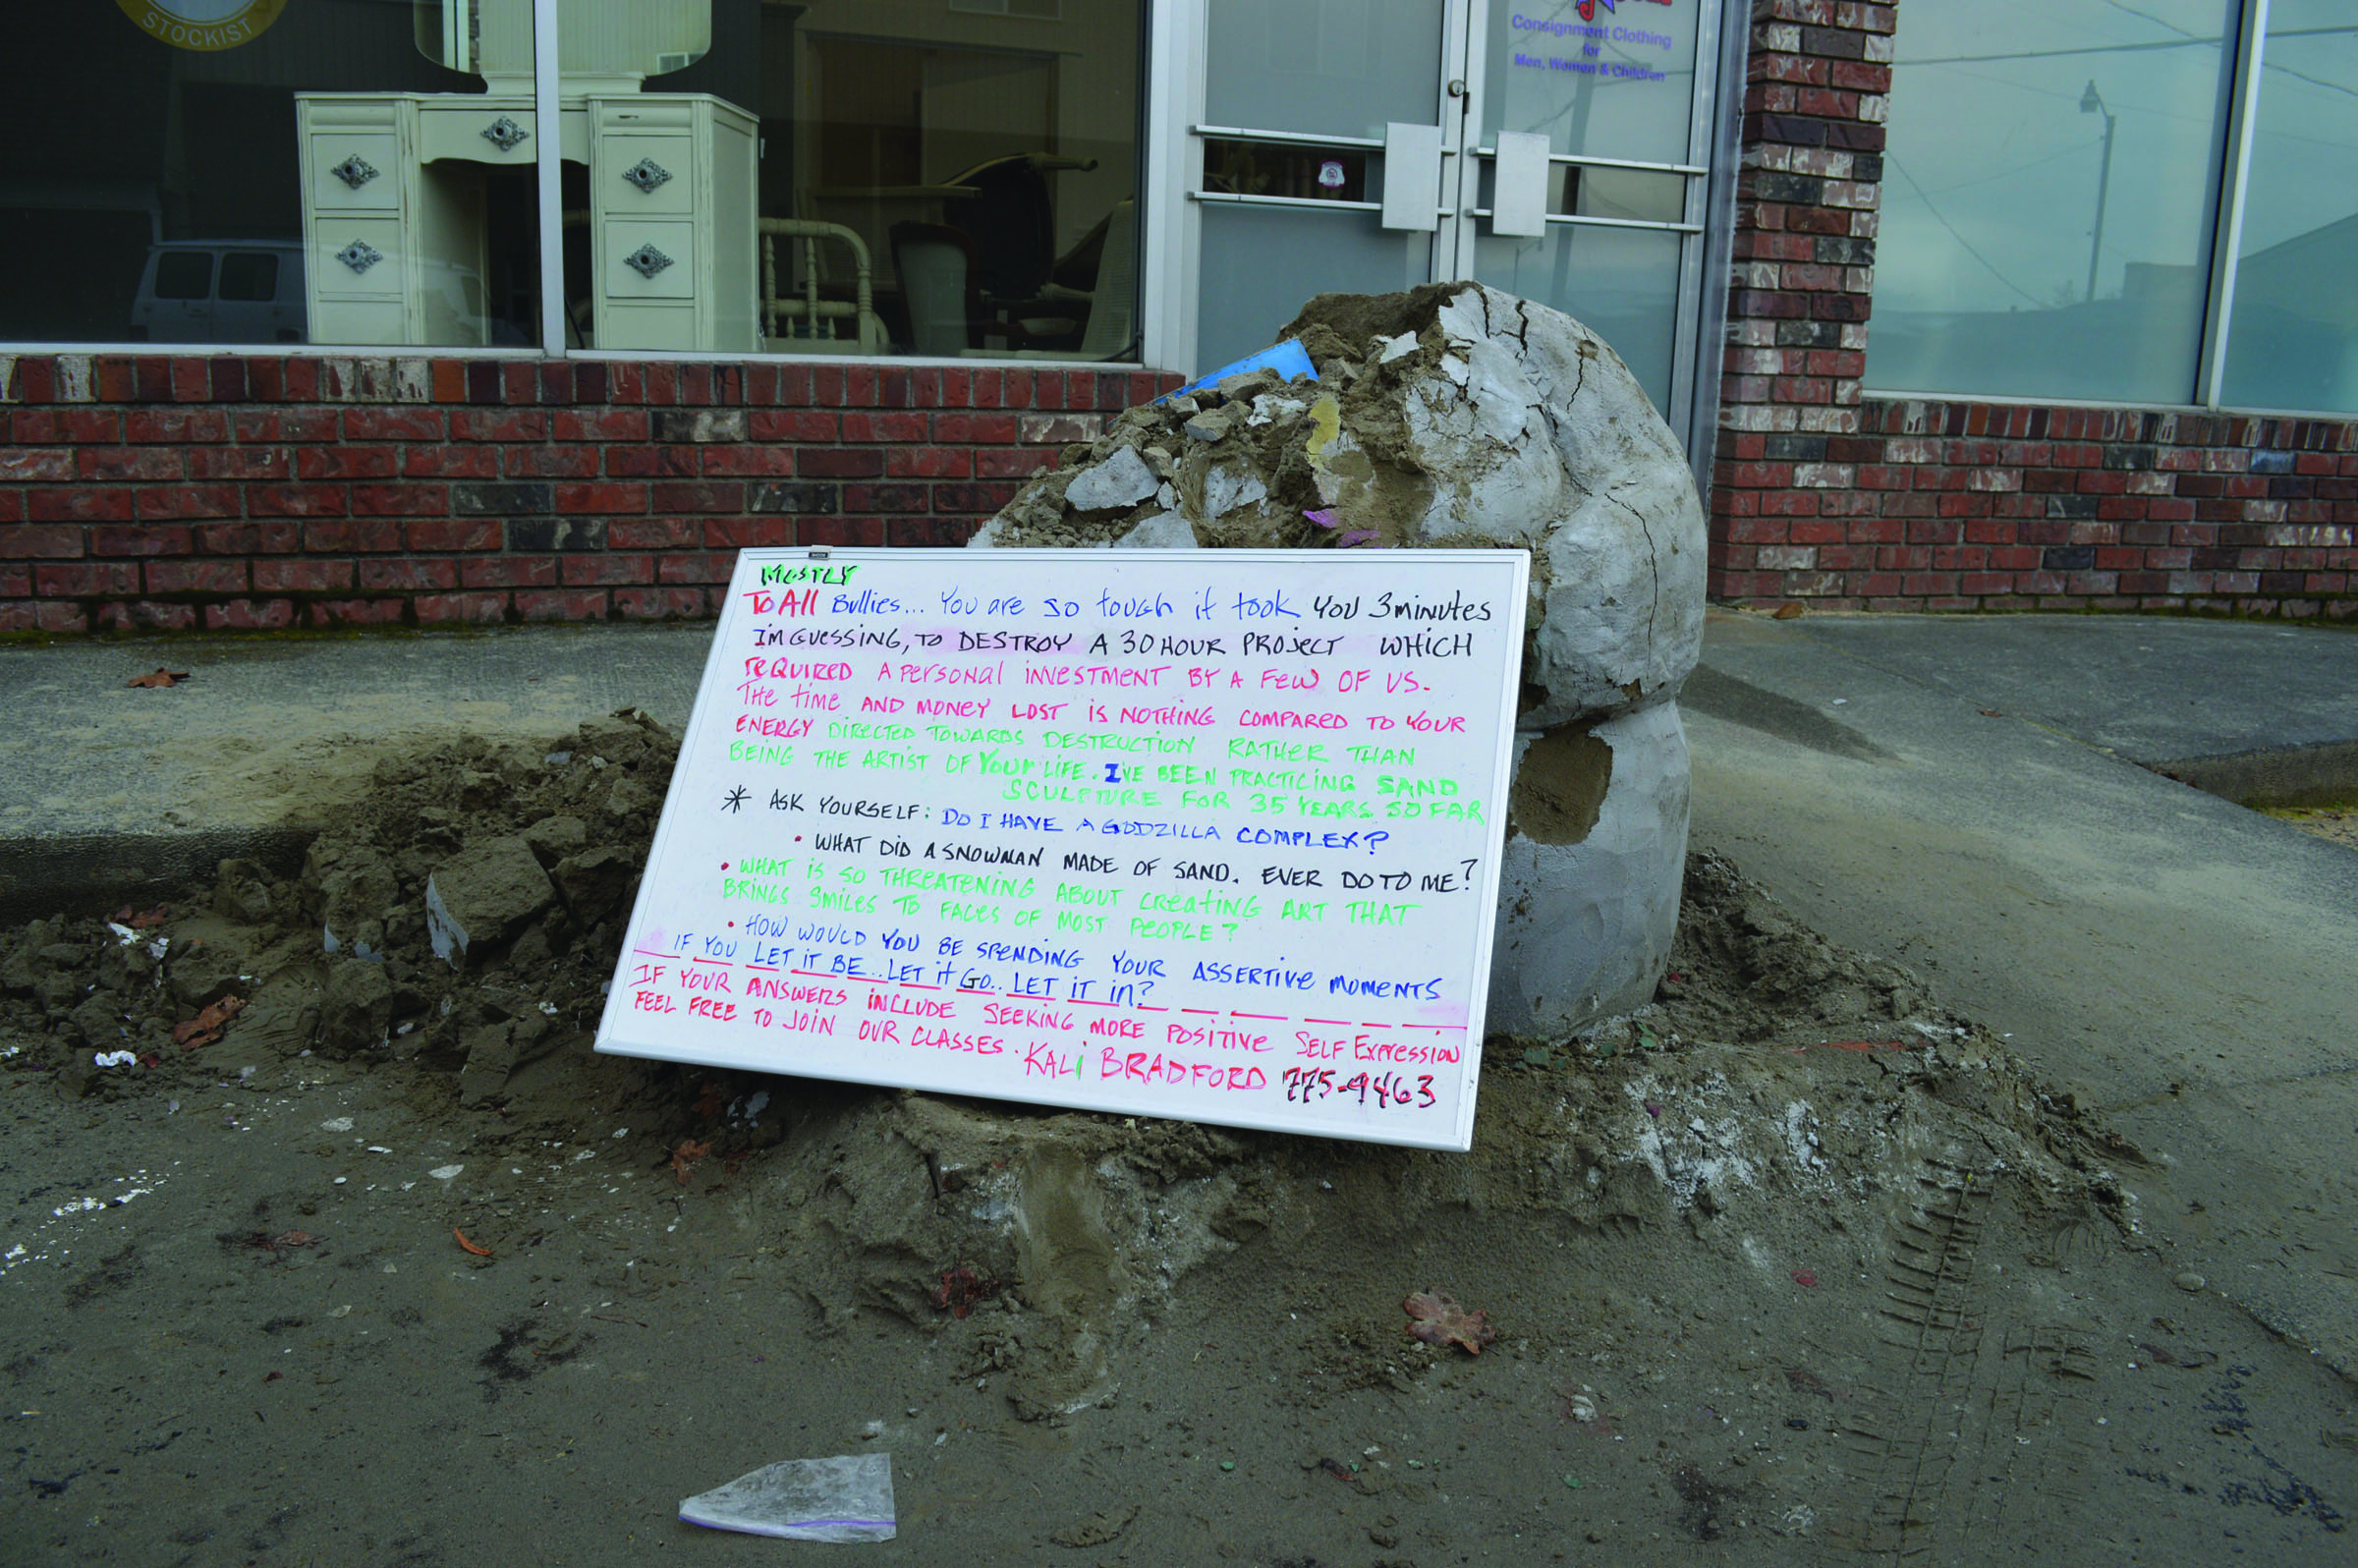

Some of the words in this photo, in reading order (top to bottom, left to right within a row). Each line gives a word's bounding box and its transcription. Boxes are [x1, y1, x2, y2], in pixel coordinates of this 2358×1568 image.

[141, 11, 252, 46] STOCKIST
[1512, 14, 1609, 39] Consignment
[1613, 26, 1672, 50] Clothing
[1583, 43, 1601, 56] for
[1514, 53, 1546, 70] Men,
[1549, 56, 1597, 75] Women
[1600, 62, 1609, 76] &
[1612, 64, 1665, 82] Children
[761, 563, 858, 587] MOSTLY
[743, 589, 775, 615] To
[778, 588, 819, 618] All
[987, 596, 1025, 616] are
[1196, 587, 1216, 620] it
[1231, 589, 1301, 620] took
[914, 634, 942, 646] TO
[958, 631, 1072, 653] DESTROY
[1089, 633, 1108, 655] A
[1380, 627, 1472, 657] WHICH
[1188, 667, 1220, 688] BY
[1230, 670, 1244, 689] A
[1338, 669, 1371, 693] OF
[736, 714, 814, 738] ENERGY
[926, 725, 1025, 745] TOWARDS
[1042, 731, 1195, 755] DESTRUCTION
[1346, 745, 1415, 765] THAN
[862, 697, 904, 713] AND
[1012, 703, 1069, 720] LOST
[1120, 700, 1215, 726] NOTHING
[1367, 716, 1395, 730] TO
[1406, 710, 1465, 733] YOUR
[730, 739, 794, 765] BEING
[814, 750, 851, 769] THE
[863, 746, 929, 770] ARTIST
[946, 755, 972, 774] OF
[1157, 764, 1216, 786] BEEN
[1229, 768, 1356, 792] PRACTICING
[1377, 774, 1458, 799] SAND
[769, 789, 804, 812] ASK
[941, 809, 971, 826] DO
[980, 813, 991, 829] I
[999, 813, 1063, 831] HAVE
[1076, 818, 1095, 831] A
[1101, 820, 1220, 840] GODZILLA
[1237, 827, 1389, 855] COMPLEX?
[1002, 778, 1161, 807] SCULPTURE
[1182, 790, 1230, 809] FOR
[1250, 793, 1288, 814] 35
[1299, 796, 1374, 819] YEARS
[1385, 802, 1421, 818] SO
[1431, 800, 1485, 825] FAR
[815, 833, 871, 854] WHAT
[880, 835, 911, 857] DID
[924, 842, 935, 859] A
[942, 843, 1044, 868] SNOWMAN
[1063, 852, 1119, 873] MADE
[1133, 858, 1161, 876] OF
[1173, 861, 1239, 884] SAND.
[1262, 866, 1322, 887] EVER
[723, 877, 789, 905] BRINGS
[893, 894, 920, 916] TO
[1014, 909, 1042, 927] OF
[1057, 912, 1108, 932] MOST
[740, 857, 794, 876] WHAT
[1056, 882, 1124, 906] ABOUT
[1281, 899, 1328, 922] ART
[1345, 901, 1423, 925] THAT
[674, 933, 694, 950] IF
[705, 935, 737, 957] YOU
[755, 942, 794, 966] LET
[885, 959, 926, 983] LET
[1011, 972, 1059, 999] LET
[746, 914, 788, 937] HOW
[798, 924, 866, 946] WOULD
[882, 929, 920, 951] YOU
[938, 937, 964, 956] BE
[1112, 950, 1166, 978] YOUR
[629, 964, 666, 987] IF
[681, 968, 731, 993] YOUR
[747, 977, 847, 1006] ANSWERS
[868, 987, 956, 1019] INCLUDE
[983, 1003, 1074, 1031] SEEKING
[1090, 1017, 1146, 1038] MORE
[635, 990, 676, 1014] FEEL
[689, 997, 737, 1022] FREE
[754, 1008, 772, 1028] TO
[782, 1008, 836, 1036] JOIN
[859, 1020, 900, 1044] OUR
[1100, 1046, 1266, 1091] BRADFORD
[1282, 1067, 1436, 1109] 775-9463
